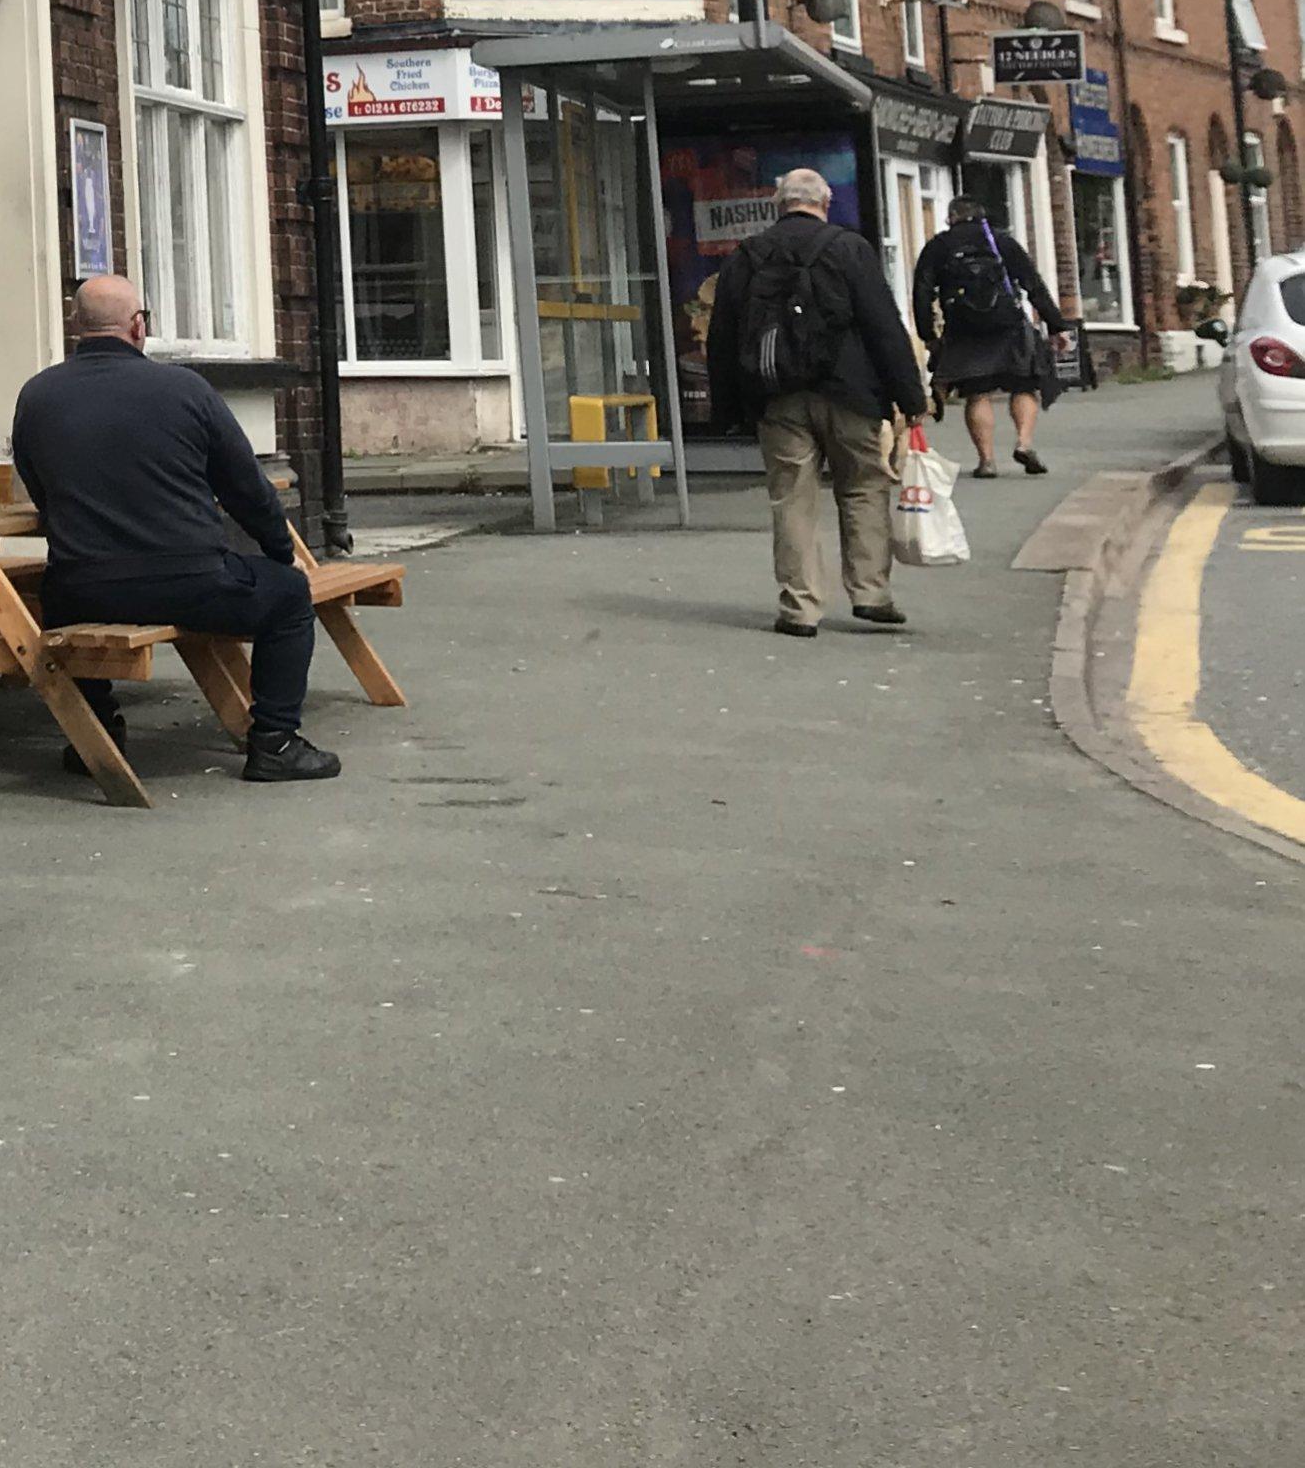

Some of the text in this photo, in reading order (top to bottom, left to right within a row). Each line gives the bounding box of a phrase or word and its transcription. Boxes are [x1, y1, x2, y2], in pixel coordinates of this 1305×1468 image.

[386, 58, 432, 70] Southern
[396, 69, 423, 80] Fried
[389, 81, 431, 93] Chicken
[365, 102, 396, 115] 01244
[399, 101, 439, 113] 676232
[709, 202, 776, 230] NASHVI
